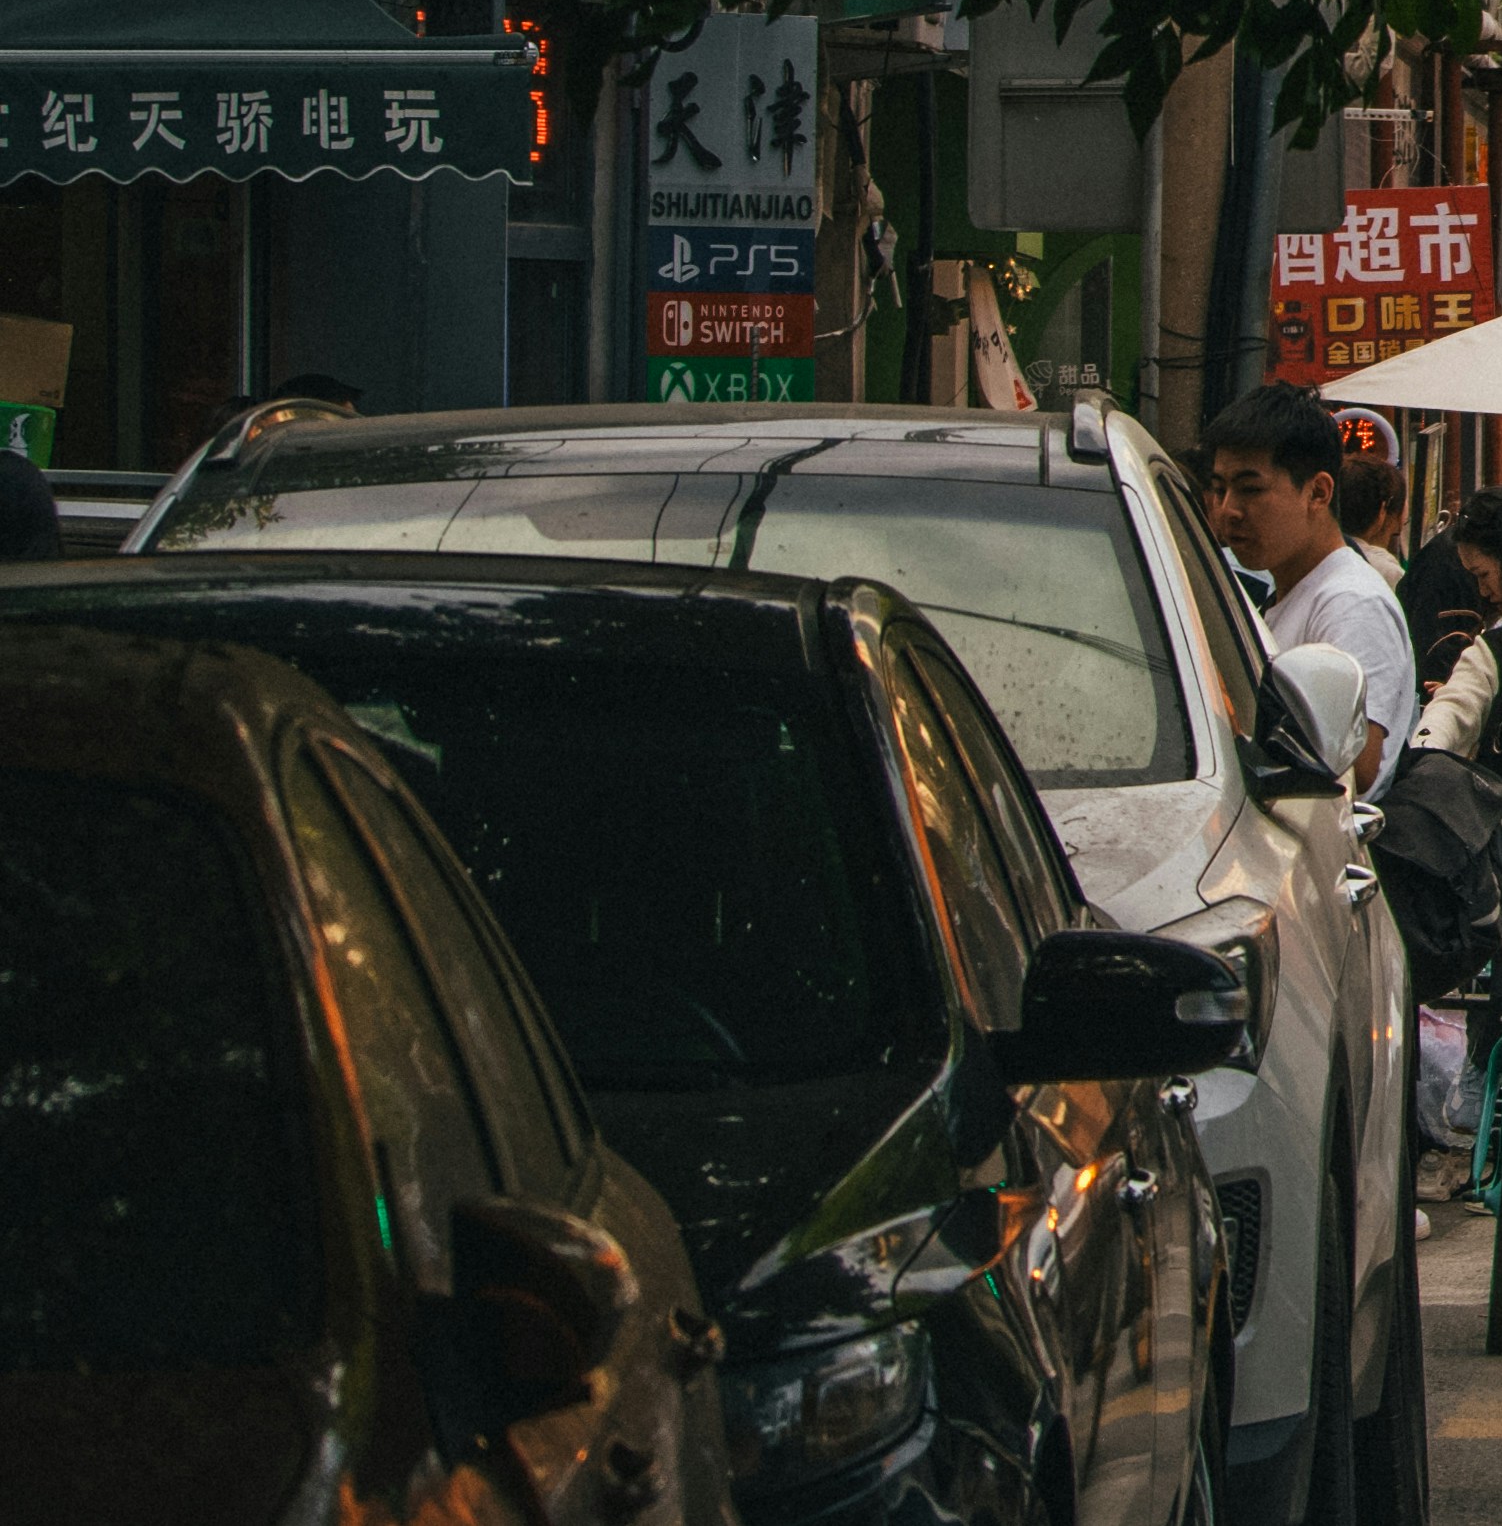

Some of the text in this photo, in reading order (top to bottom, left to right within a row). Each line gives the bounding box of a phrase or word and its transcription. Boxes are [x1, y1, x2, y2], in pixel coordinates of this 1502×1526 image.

[0, 88, 445, 154] 纪天骄电玩
[651, 57, 811, 177] 天津
[651, 190, 813, 222] SHIJITIANJIAO
[708, 243, 801, 277] PS5
[700, 304, 785, 317] NINTENDO
[1326, 292, 1476, 333] 口味王
[699, 320, 785, 345] SWITCH
[704, 374, 793, 402] XBOX
[1058, 363, 1100, 385] 甜品
